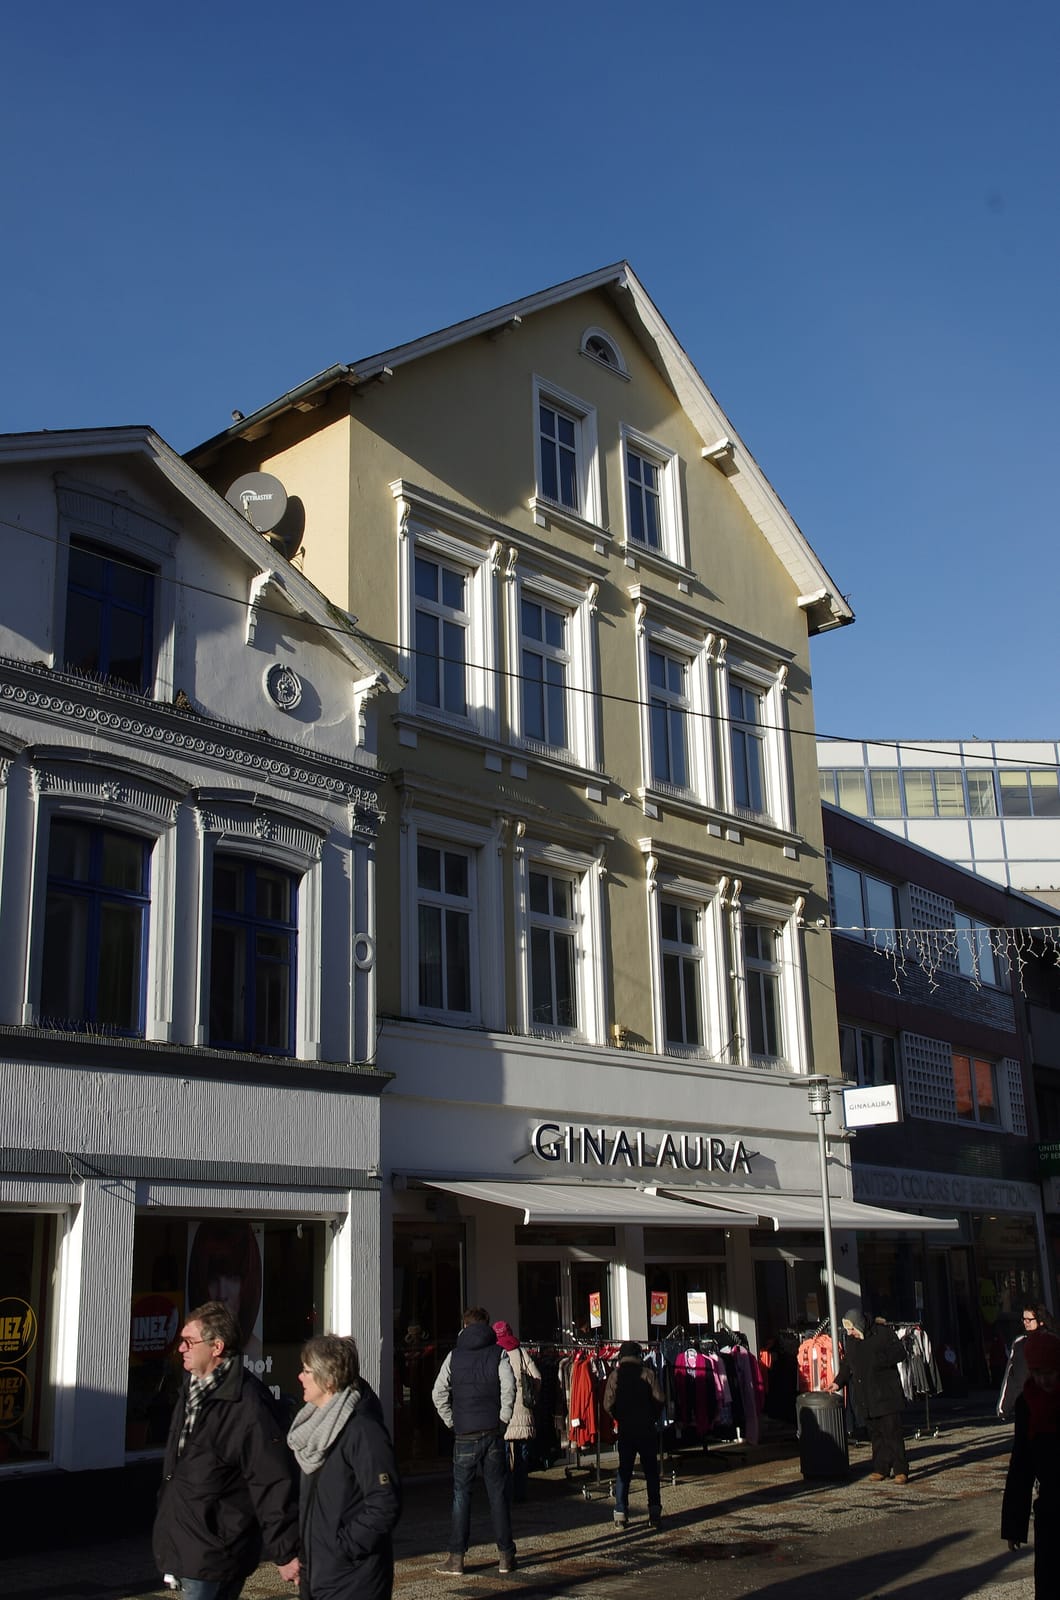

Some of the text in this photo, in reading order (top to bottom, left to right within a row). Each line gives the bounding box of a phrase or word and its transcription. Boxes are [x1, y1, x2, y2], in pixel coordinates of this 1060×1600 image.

[849, 1100, 892, 1111] GINALAURA
[532, 1121, 754, 1175] GINALAURA
[1038, 1144, 1060, 1152] UNITE
[134, 1315, 168, 1339] INEZ
